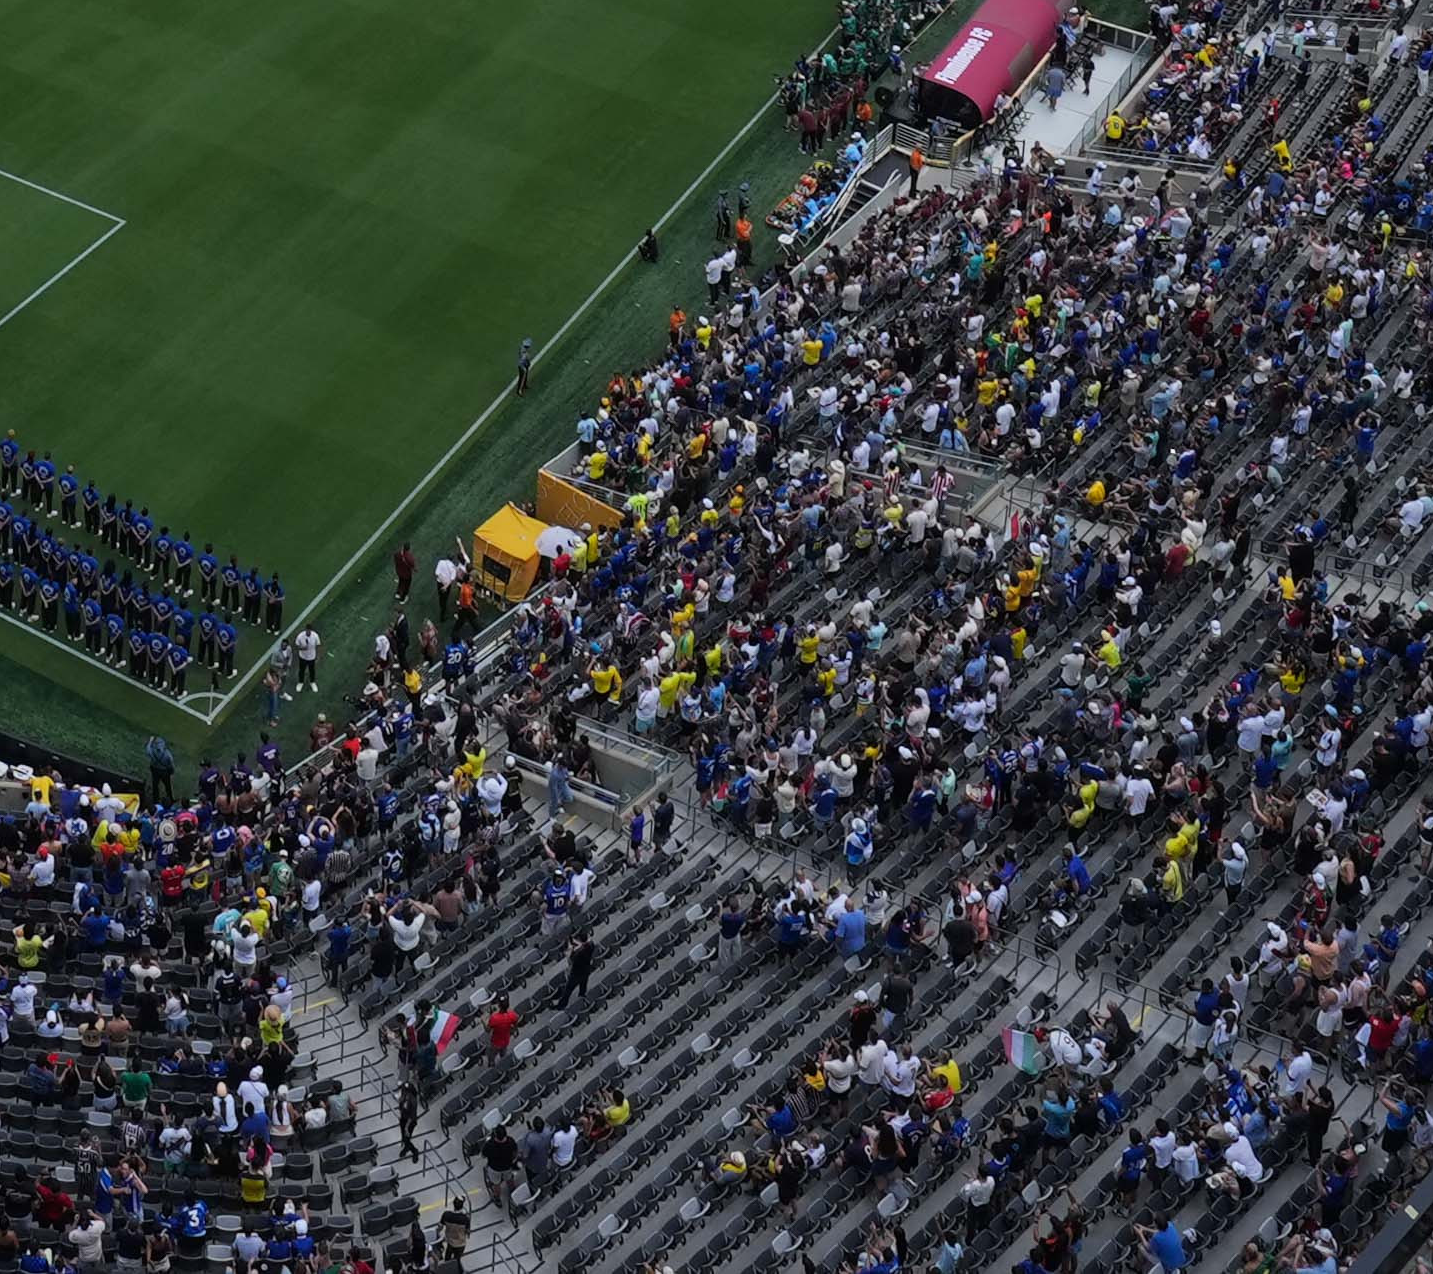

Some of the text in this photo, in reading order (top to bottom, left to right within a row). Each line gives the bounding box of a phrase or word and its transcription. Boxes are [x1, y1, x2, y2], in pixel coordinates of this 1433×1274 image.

[934, 36, 986, 85] Fluminense
[969, 27, 994, 42] FC
[447, 652, 462, 665] 20
[553, 897, 564, 909] 10
[188, 1209, 199, 1226] 3
